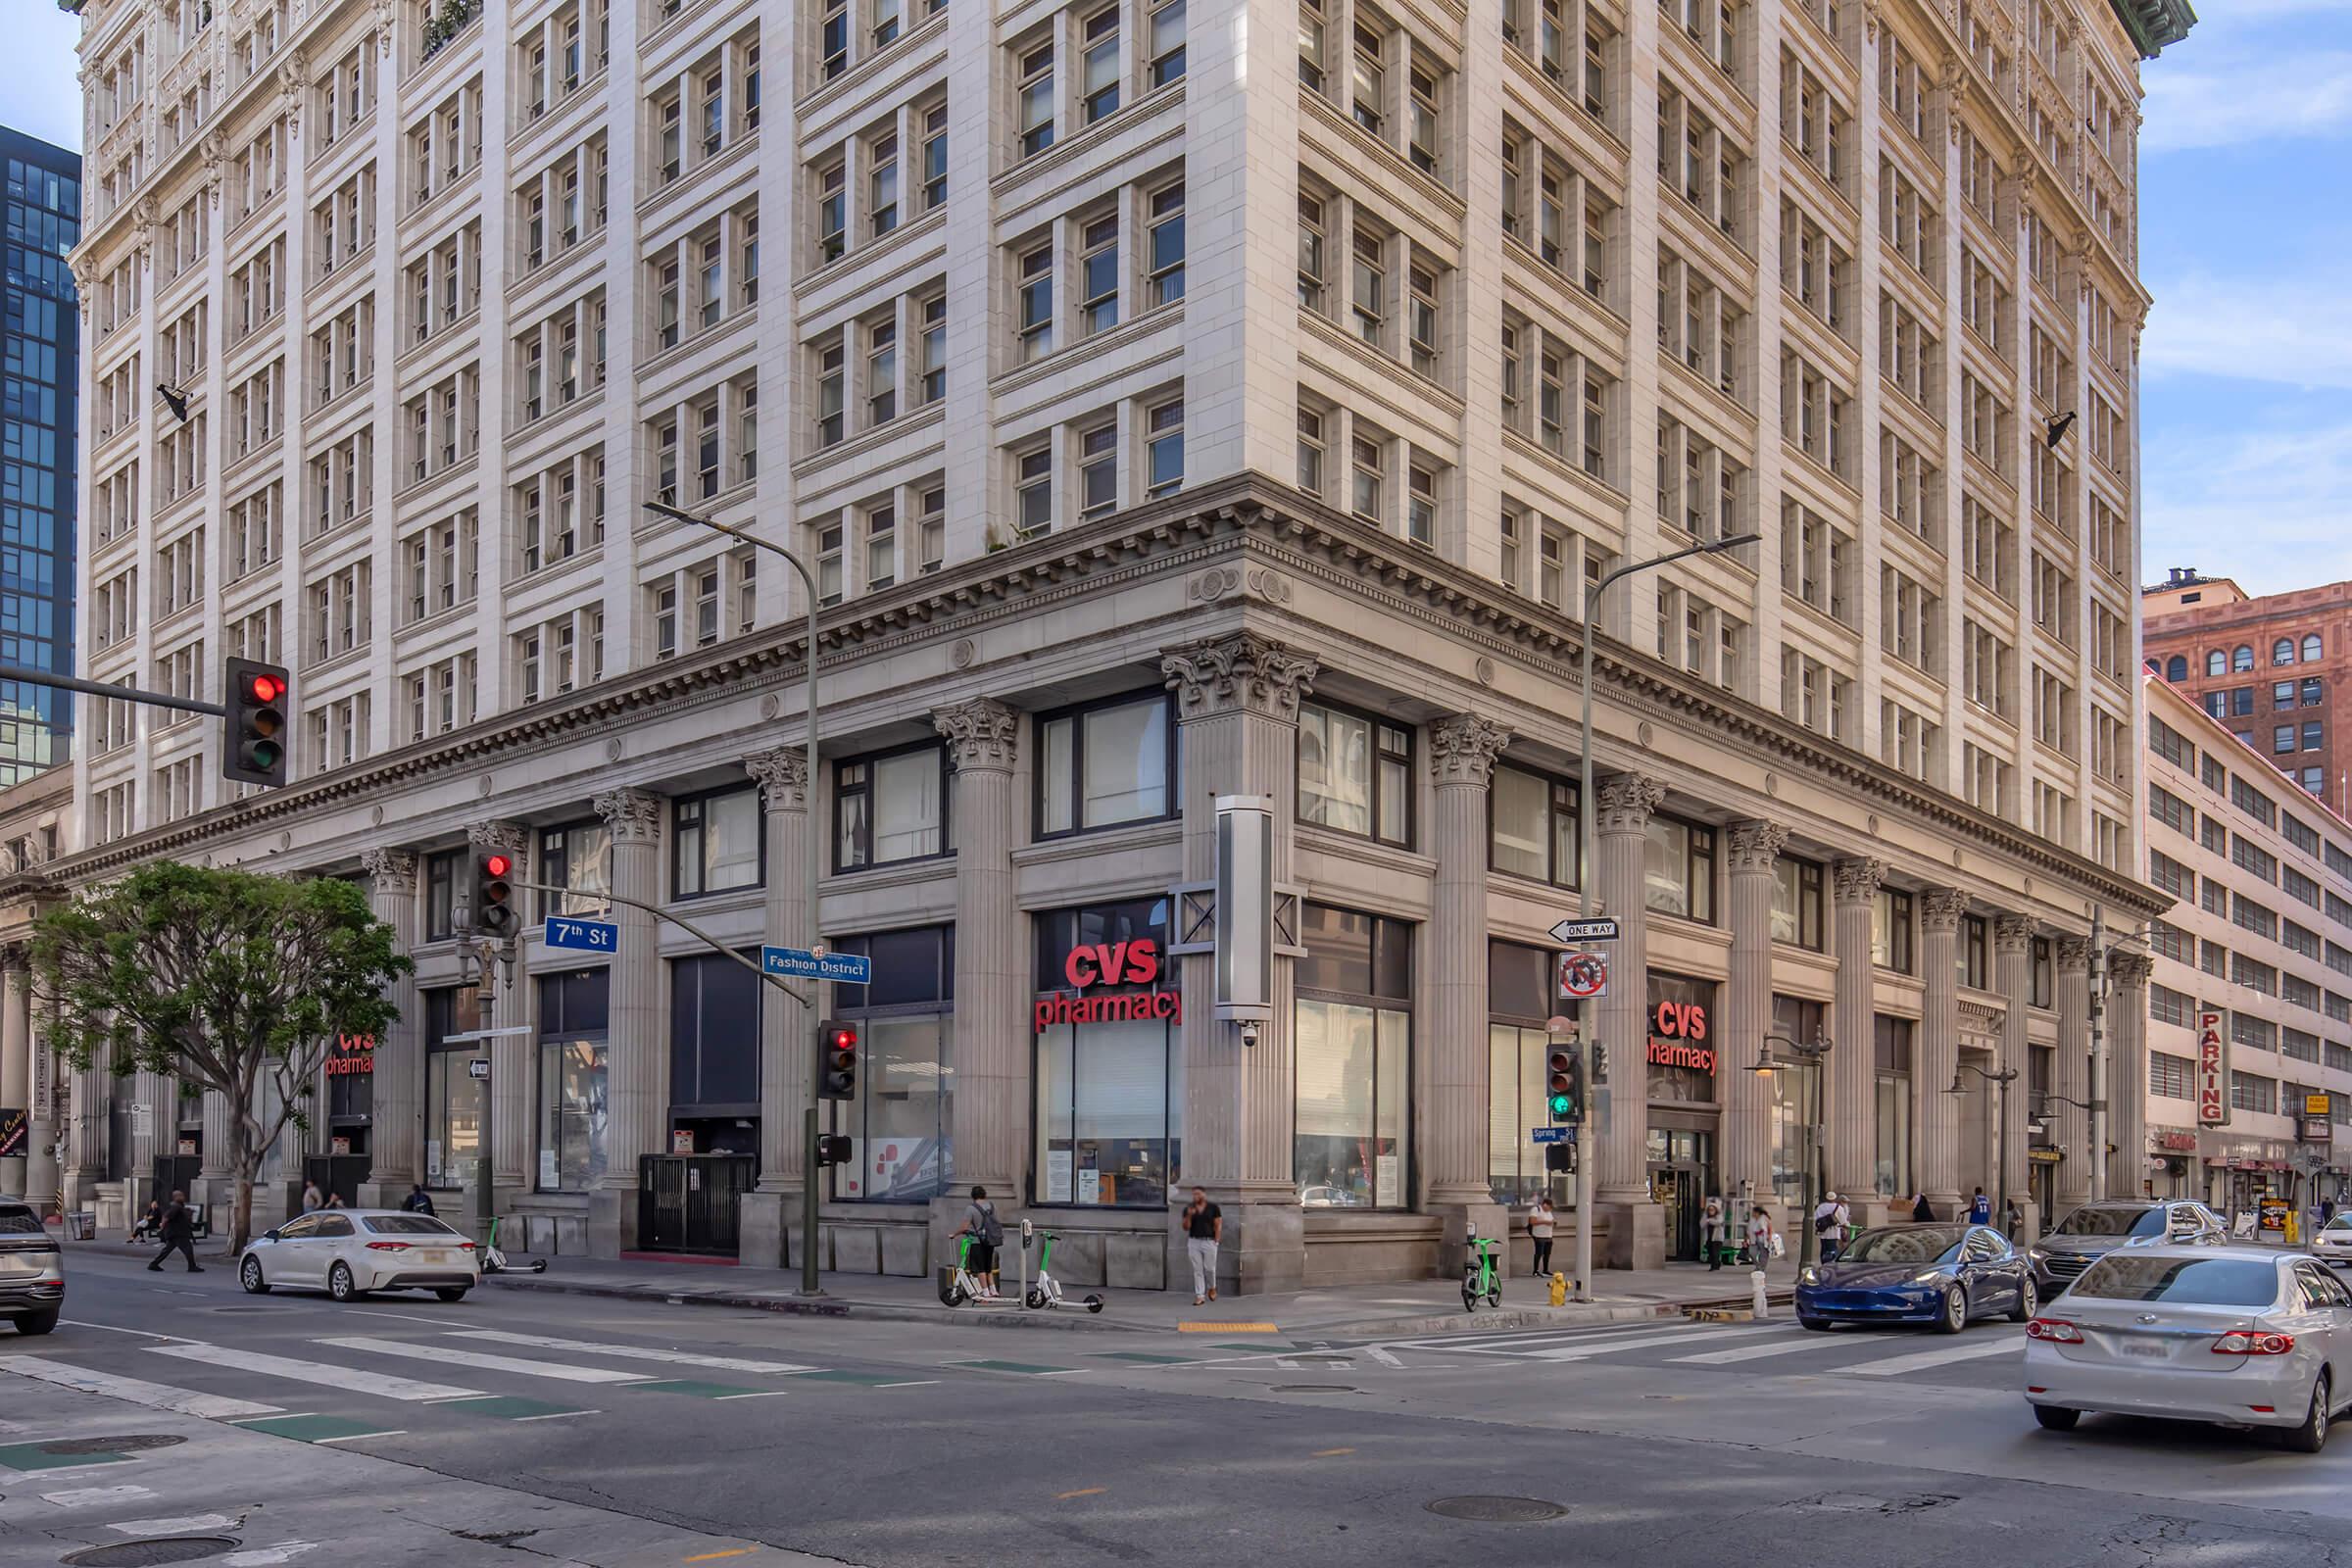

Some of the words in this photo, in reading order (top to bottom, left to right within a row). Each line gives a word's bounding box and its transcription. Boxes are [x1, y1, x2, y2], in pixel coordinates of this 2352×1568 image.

[556, 923, 583, 943] 7th
[589, 929, 609, 946] St
[1569, 926, 1589, 935] ONE
[1592, 924, 1612, 933] WAY
[769, 955, 817, 971] Fashion
[820, 960, 864, 976] District
[1065, 939, 1157, 988] CVS
[1657, 1001, 1706, 1041] CVS
[325, 1054, 375, 1082] pharma
[2202, 1013, 2221, 1119] PARKING
[1534, 1129, 1555, 1139] Spring
[1980, 1204, 1987, 1213] 11
